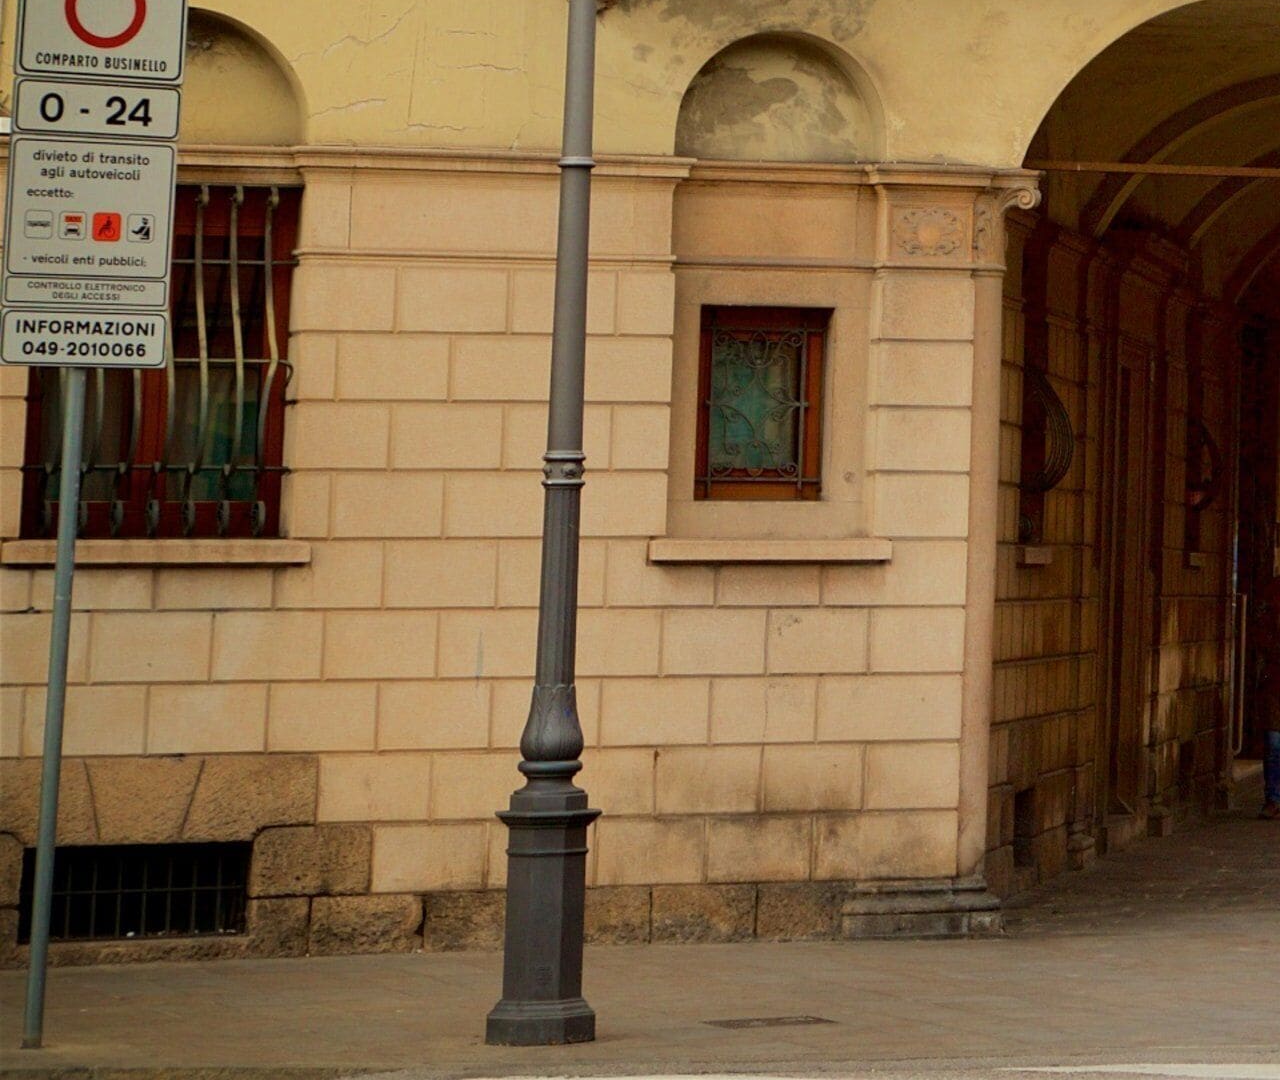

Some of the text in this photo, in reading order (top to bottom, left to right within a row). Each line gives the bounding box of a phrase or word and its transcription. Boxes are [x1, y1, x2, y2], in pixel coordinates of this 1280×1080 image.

[35, 51, 168, 73] COMPARTO BUSINELLO
[39, 92, 153, 127] 0 - 24
[32, 149, 150, 166] divieto di transito
[40, 166, 141, 181] agli autoveicoli
[31, 253, 69, 265] veicoli
[72, 254, 95, 266] enti
[27, 280, 146, 293] CONTROLLO ELETTRONICO
[52, 291, 120, 301] DEGLI ACCESSI
[15, 319, 156, 337] INFORMAZIONI
[22, 341, 147, 357] 049-2010066
